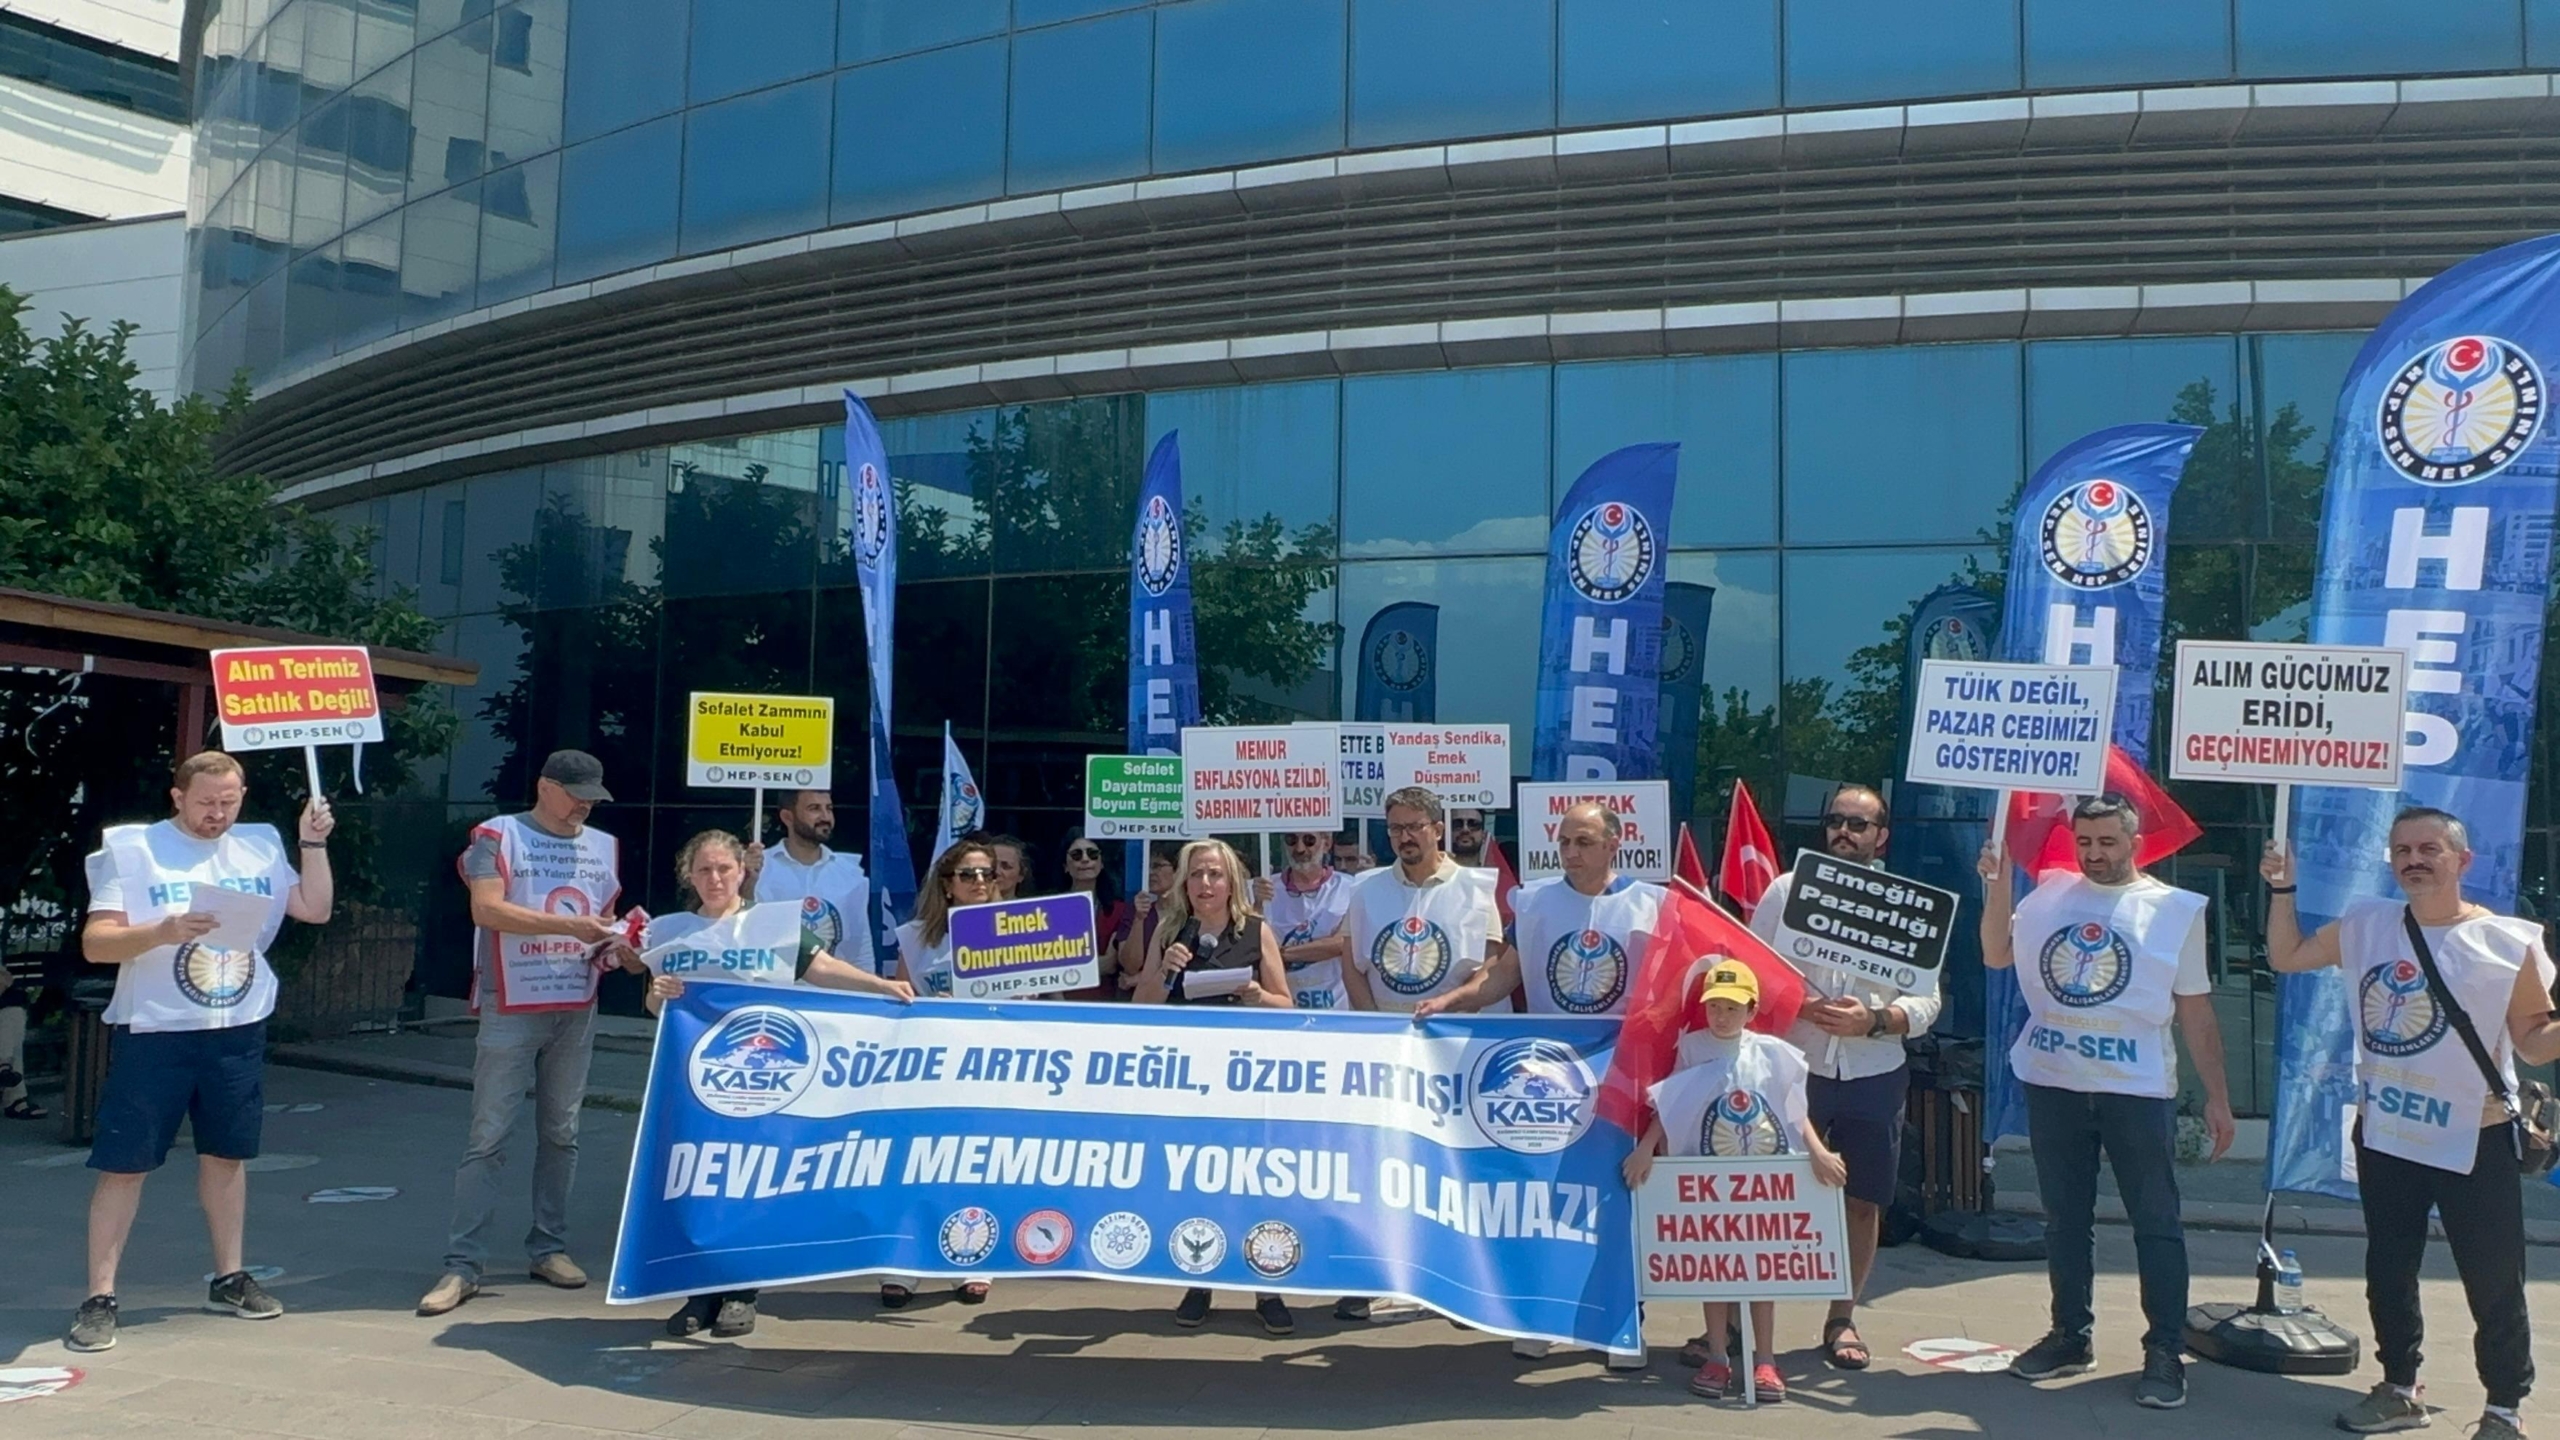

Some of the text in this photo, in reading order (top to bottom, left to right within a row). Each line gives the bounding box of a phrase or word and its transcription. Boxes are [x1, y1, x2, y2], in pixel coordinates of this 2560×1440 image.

[228, 656, 361, 683] Alın Terimiz
[2192, 655, 2391, 693] ALIM GÜCÜMÜZ
[224, 687, 373, 717] Satılık Değil!
[1944, 671, 2090, 710] TÜİK DEĞİL,
[697, 700, 828, 720] Sefalet Zammını
[1925, 708, 2100, 742] PAZAR CEBİMİZİ
[2242, 692, 2333, 736] ERİDİ,
[268, 726, 343, 740] HEP-SEN
[739, 723, 785, 738] Kabul
[1388, 730, 1507, 749] Yandaş Sendika,
[719, 742, 803, 761] Etmiyoruz!
[1235, 739, 1288, 761] MEMUR
[1427, 751, 1468, 765] Emek
[1935, 737, 2081, 777] GÖSTERİYOR!
[2186, 728, 2390, 771] GEÇİNEMİYORUZ!
[726, 770, 793, 782] HEP-SEN
[1123, 760, 1175, 777] Sefalet
[1194, 761, 1332, 792] ENFLASYONA EZİLDİ,
[1413, 769, 1482, 788] Düşmanı!
[1092, 797, 1137, 813] Boyun
[1195, 790, 1332, 821] SABRIMIZ TÜKENDİ!
[1118, 823, 1177, 835] HEP-SEN
[1814, 862, 1936, 913] Emeğin
[994, 906, 1050, 937] Emek
[1798, 883, 1939, 940] Pazarlığı
[956, 930, 1092, 973] Onurumuzdur!
[1806, 912, 1919, 960] Olmaz!
[661, 948, 776, 975] HEP-SEN
[1815, 947, 1893, 980] HEP-SEN
[991, 974, 1060, 993] HEP-SEN
[2027, 1024, 2138, 1063] HEP-SEN
[700, 1067, 798, 1092] KASK
[822, 1040, 1464, 1127] SÖZDE ARTIŞ DEĞİL, ÖZDE ARTIŞ!
[1486, 1100, 1583, 1128] KASK
[2364, 1082, 2452, 1130] -SEN
[662, 1129, 1600, 1246] DEVLETİN MEMURU YOKSUL OLAMAZ!
[1677, 1173, 1796, 1203] EK ZAM
[1655, 1212, 1823, 1247] HAKKIMIZ,
[1648, 1243, 1838, 1283] SADAKA DEĞİL!
